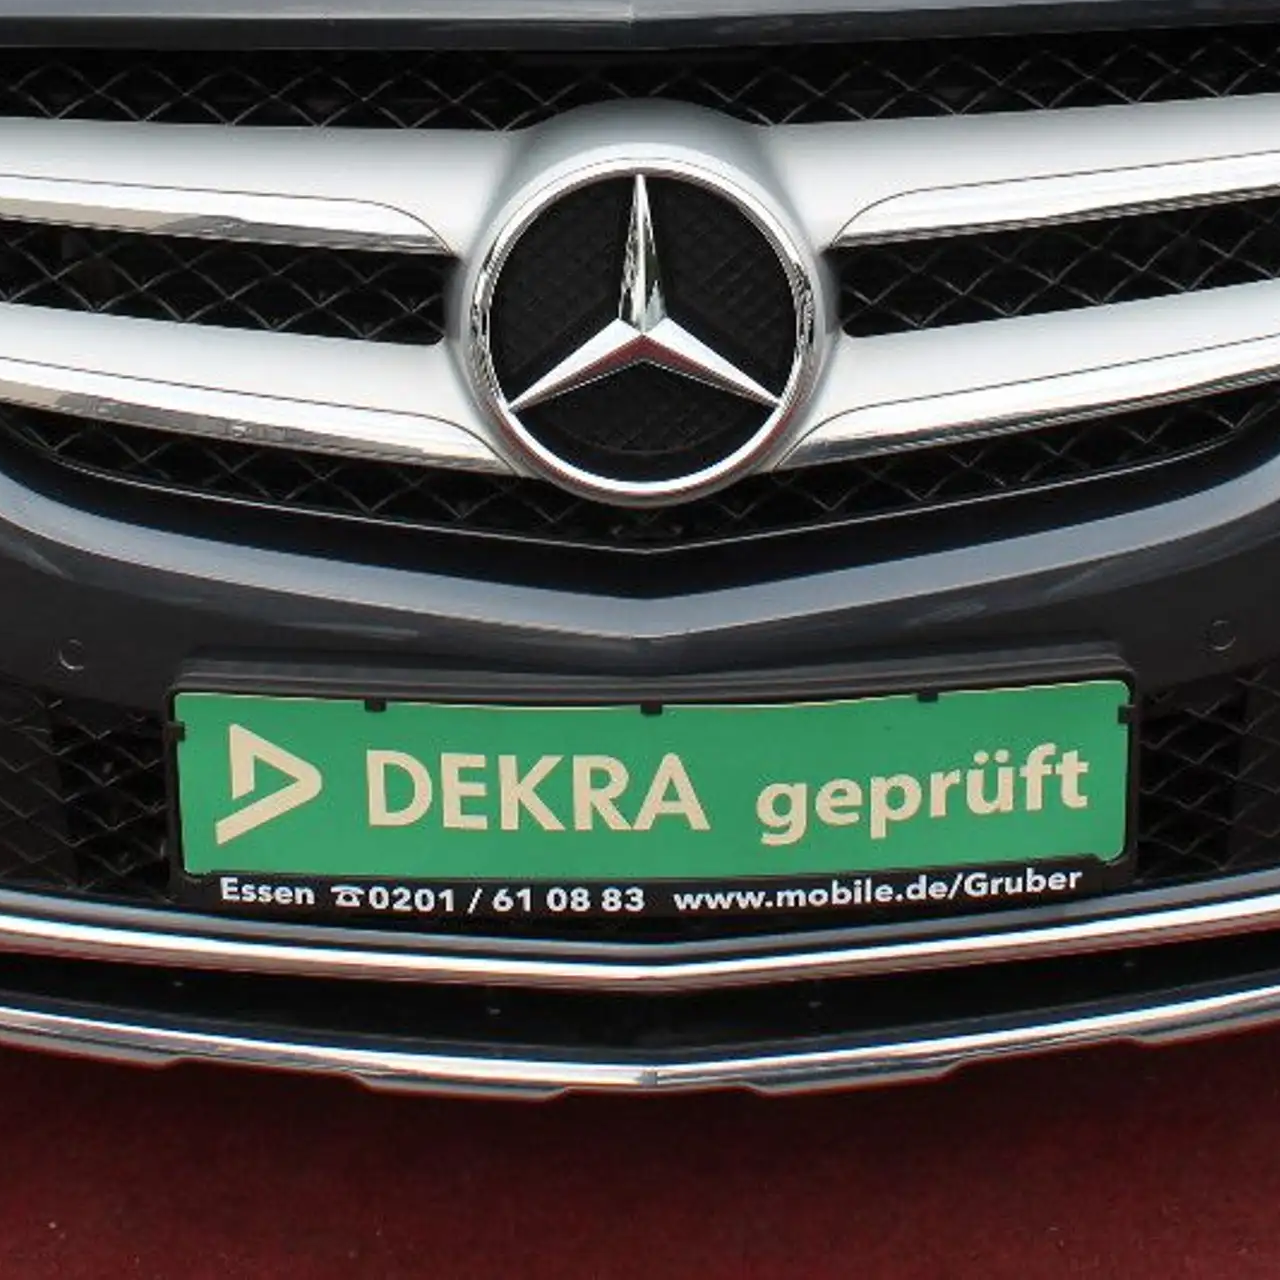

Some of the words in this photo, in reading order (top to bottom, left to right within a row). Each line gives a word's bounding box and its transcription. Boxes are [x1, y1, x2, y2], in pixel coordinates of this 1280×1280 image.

[365, 749, 711, 831] DEKRA
[755, 742, 1088, 846] geprüft
[220, 876, 315, 906] Essen
[492, 887, 532, 912] 61
[546, 887, 591, 912] 08
[601, 886, 645, 911] 83
[673, 867, 1083, 910] www.mobile.de/Gruber
